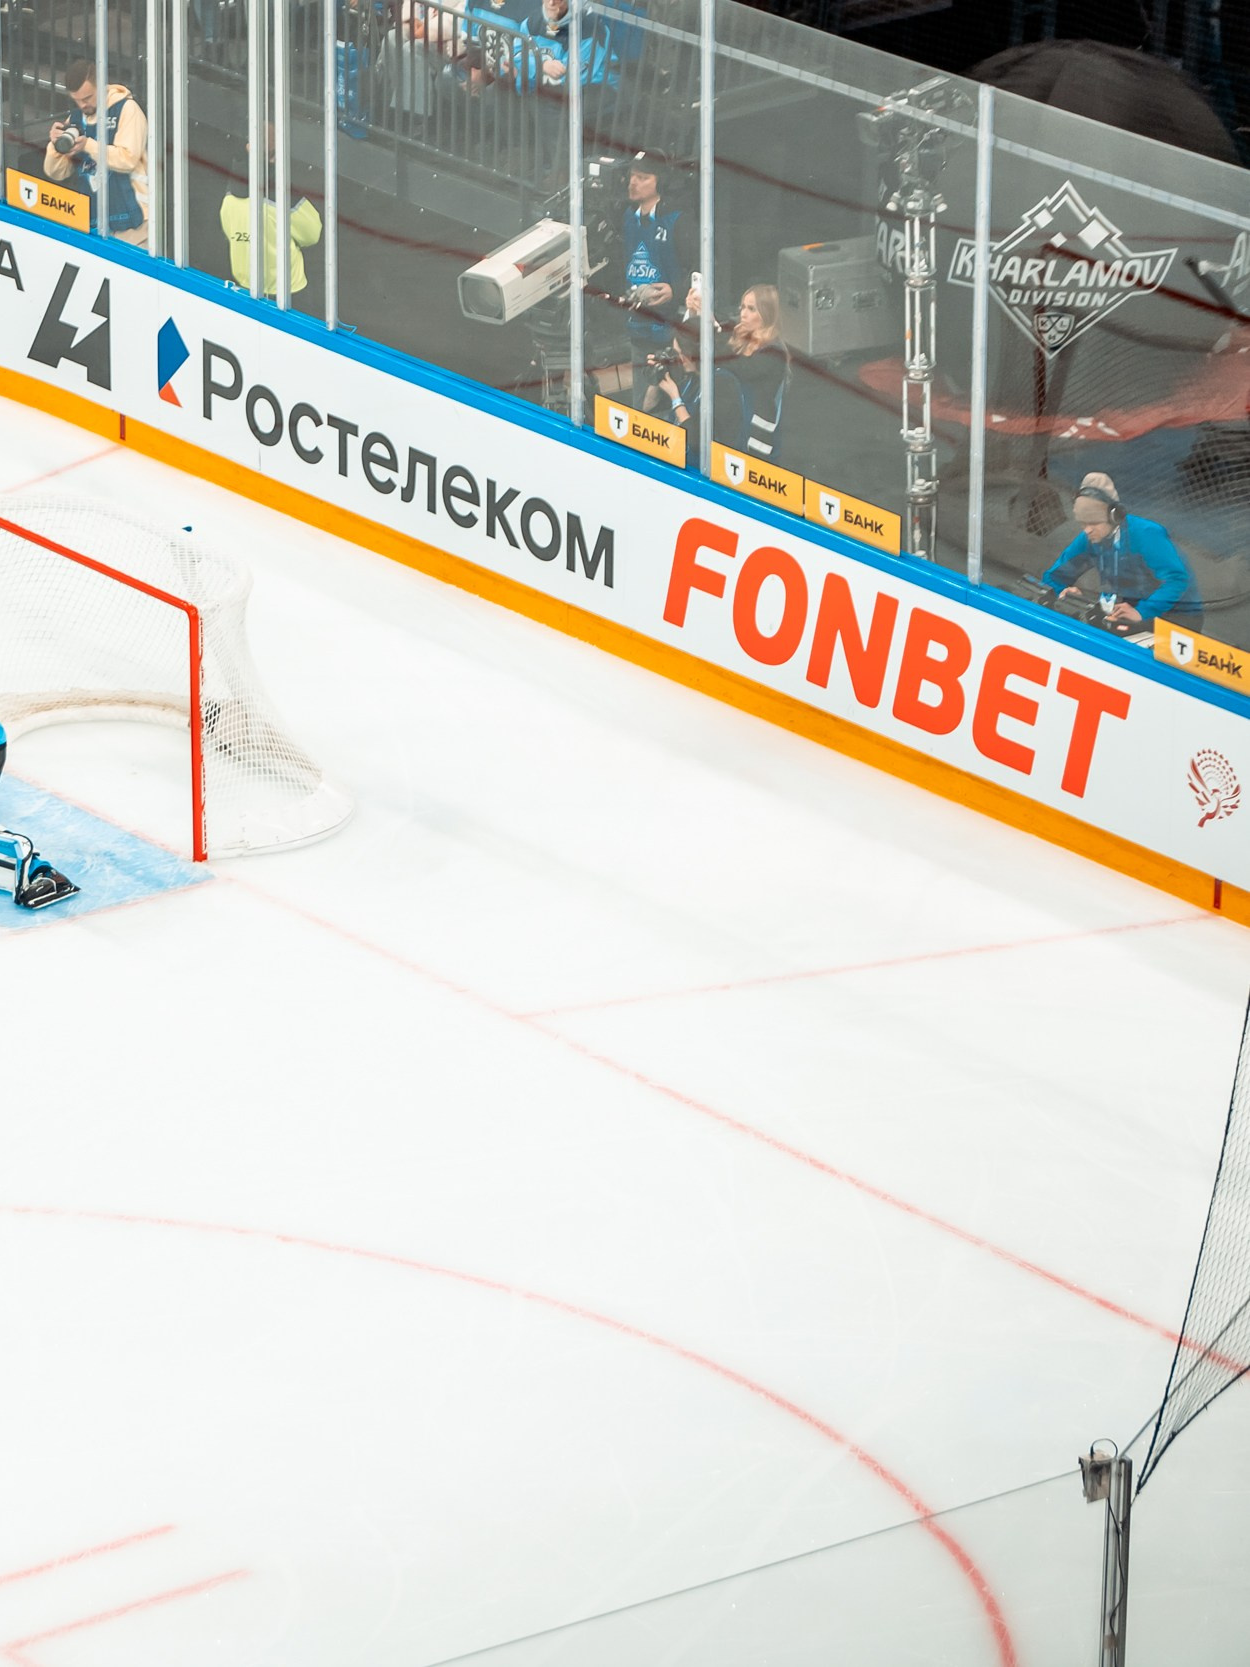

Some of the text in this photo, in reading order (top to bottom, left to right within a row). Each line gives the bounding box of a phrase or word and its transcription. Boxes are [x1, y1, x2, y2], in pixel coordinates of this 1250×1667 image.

[41, 193, 76, 216] БАНК
[955, 245, 1167, 289] KHARLAMOV
[1008, 289, 1108, 309] DIVISION
[632, 423, 670, 449] БАНК
[202, 338, 615, 589] Ростелеком
[748, 470, 787, 496] БАНК
[843, 509, 884, 536] БАНК
[663, 518, 1132, 799] FONBET
[1197, 649, 1243, 679] БАНК
